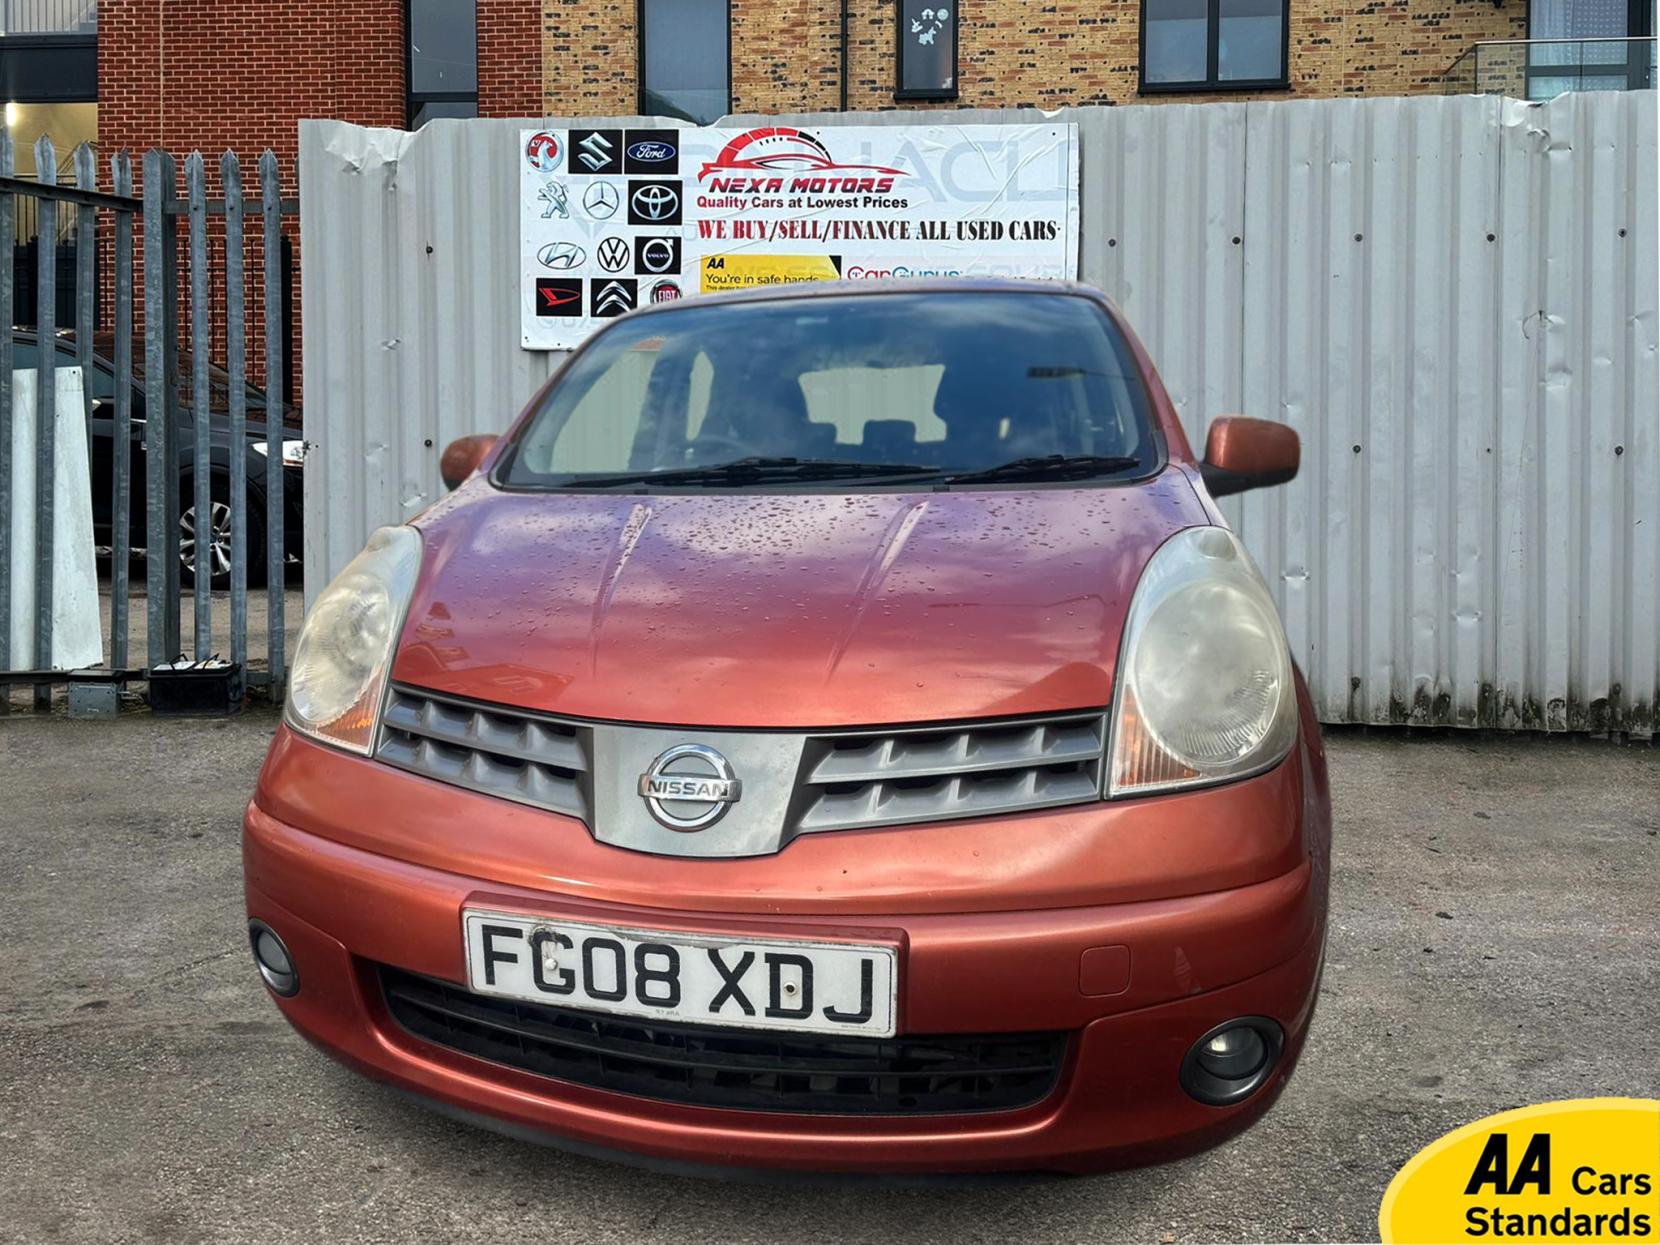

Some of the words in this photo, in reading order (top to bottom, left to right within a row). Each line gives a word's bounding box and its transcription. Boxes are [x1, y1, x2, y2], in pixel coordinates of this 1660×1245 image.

[636, 144, 666, 159] Ford
[708, 177, 781, 193] NEXA
[789, 177, 895, 193] MOTORS
[697, 195, 747, 210] Quality
[751, 196, 784, 208] Cars
[788, 197, 803, 208] at
[807, 196, 859, 208] Lowest
[863, 196, 908, 208] Prices
[698, 219, 726, 240] WE
[733, 219, 911, 242] BUY/SELL/FINANCE
[916, 220, 951, 240] ALL
[957, 220, 1004, 240] USED
[706, 257, 725, 269] AA
[706, 274, 741, 284] You're
[744, 274, 754, 284] in
[757, 274, 781, 284] safe
[658, 290, 677, 302] FIAT
[647, 779, 729, 797] NISSAN
[481, 923, 682, 1008] FG08
[707, 947, 874, 1025] XDJ
